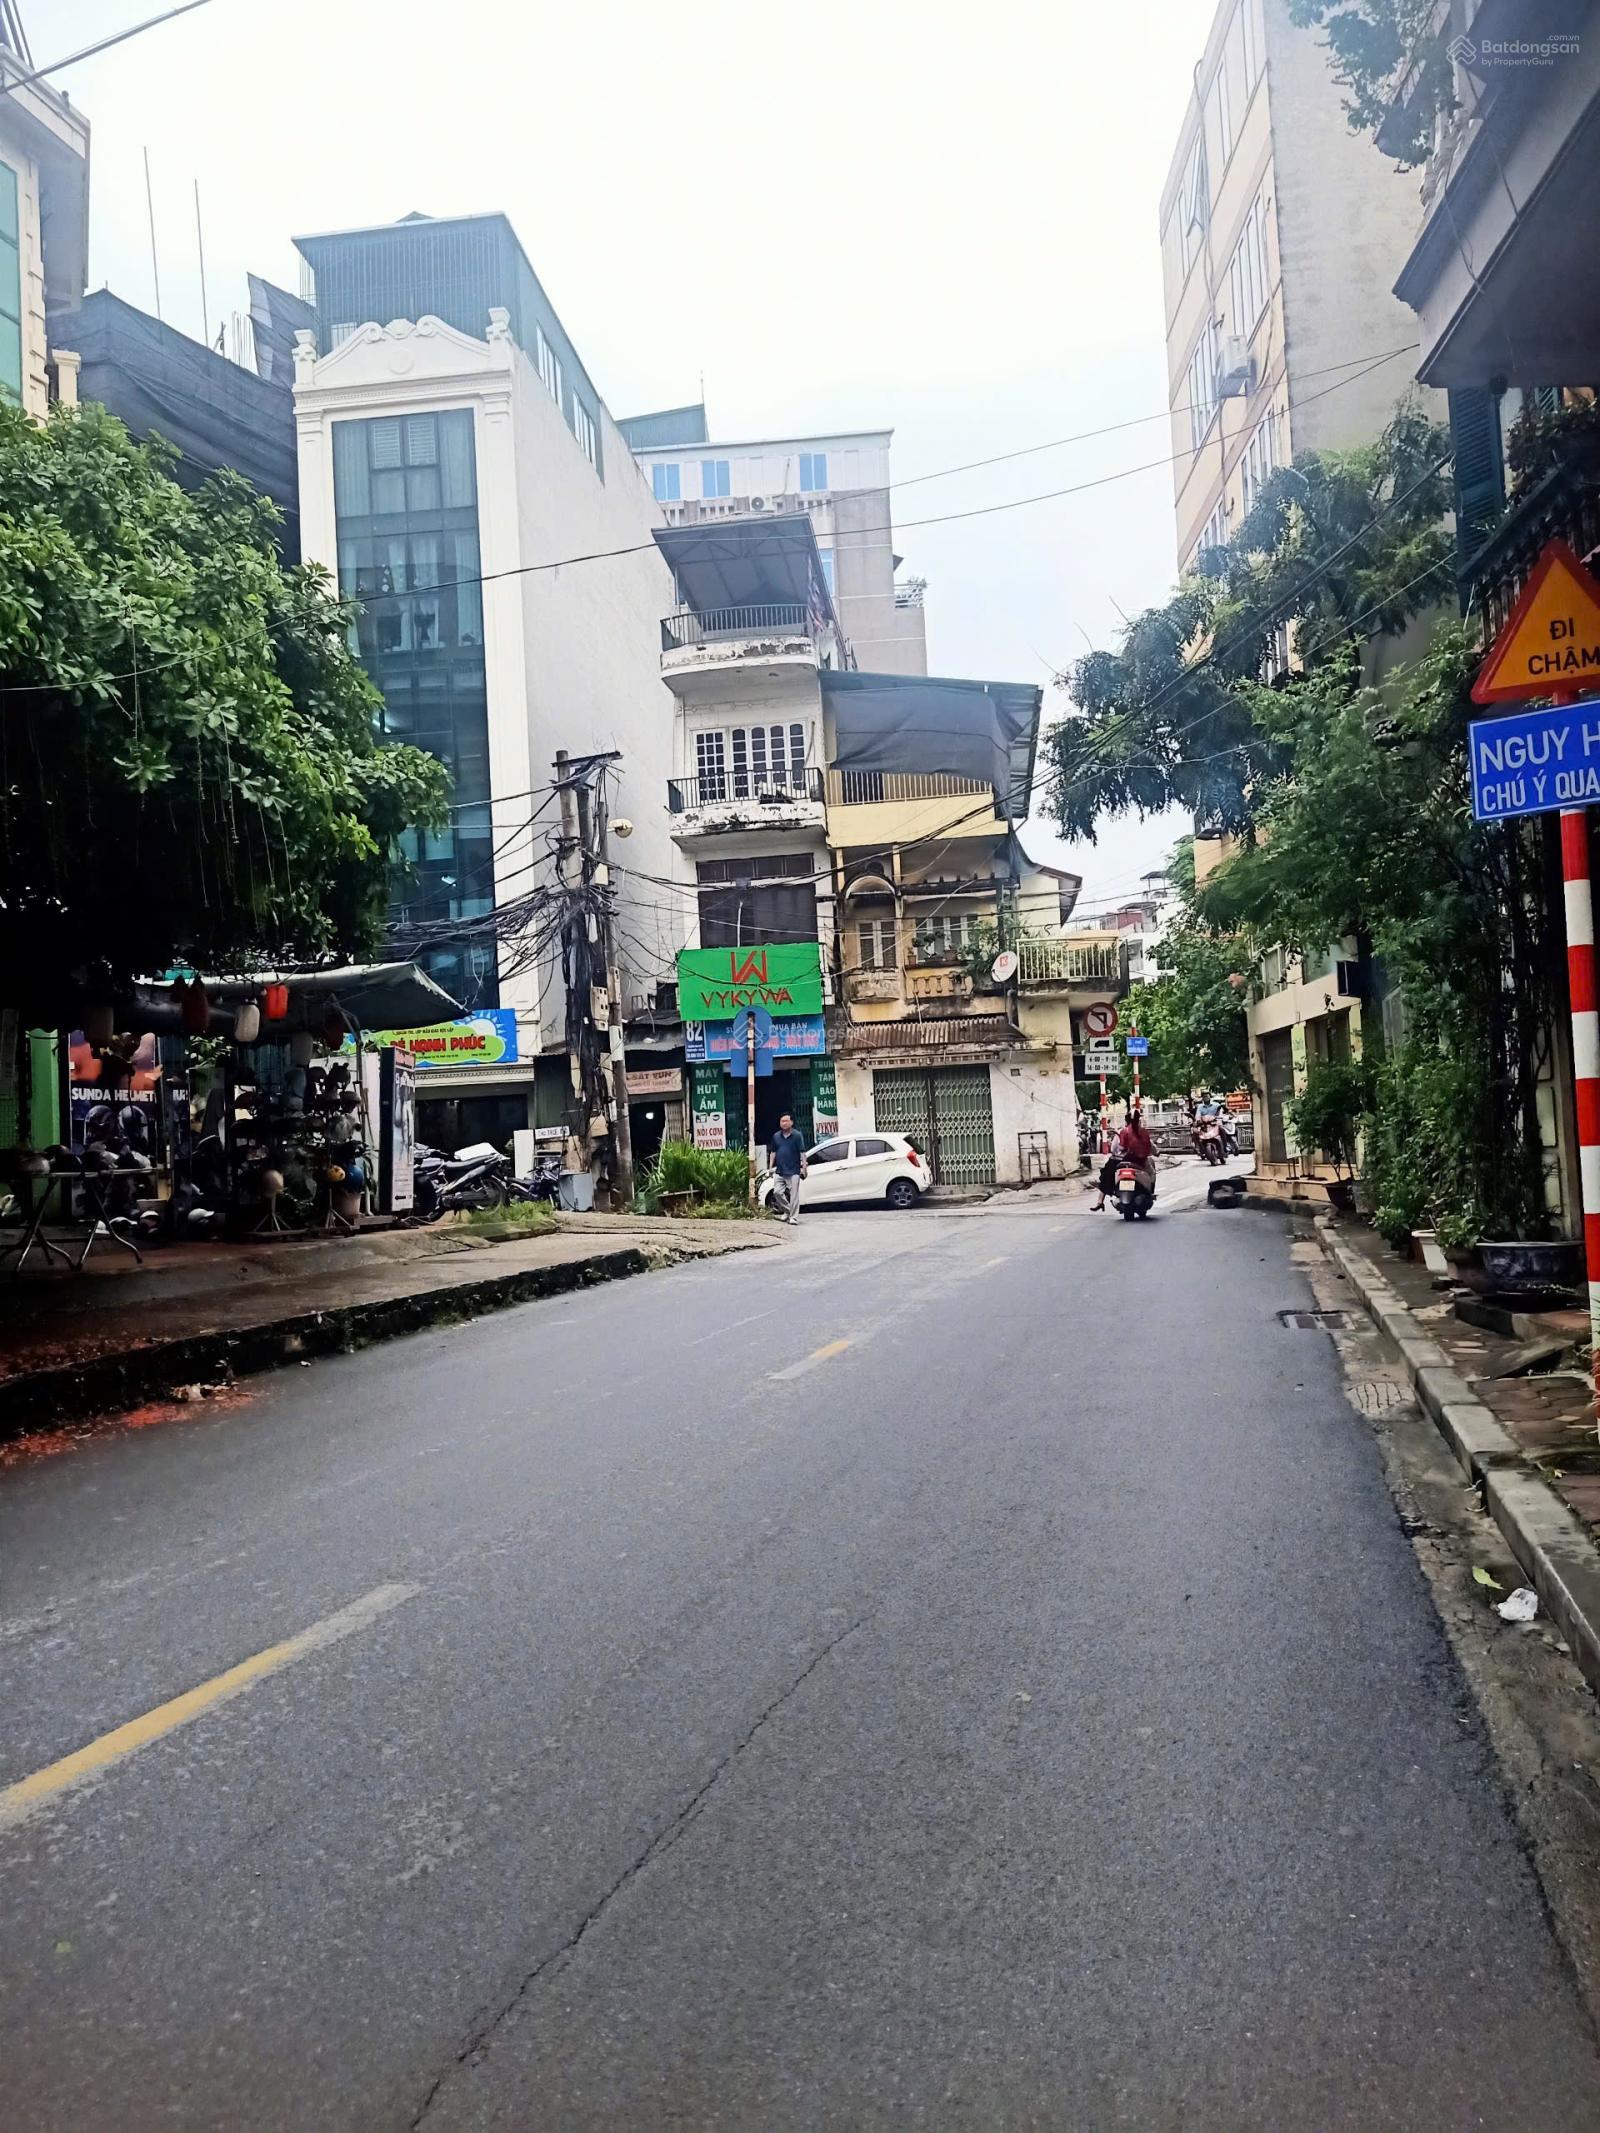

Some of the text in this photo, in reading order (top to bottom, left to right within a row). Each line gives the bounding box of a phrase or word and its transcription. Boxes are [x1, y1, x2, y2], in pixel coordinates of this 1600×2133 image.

[1550, 618, 1575, 640] ĐI
[1528, 646, 1600, 675] CHẬM
[1479, 727, 1570, 774] NGUY
[1482, 772, 1526, 812] CHÚ
[1532, 769, 1547, 803] Ý
[700, 988, 793, 1008] VYKYWA
[686, 1020, 703, 1041] 82
[450, 1033, 486, 1050] PHÚC
[71, 1088, 112, 1100] SUNDA
[696, 1082, 719, 1094] HÚT
